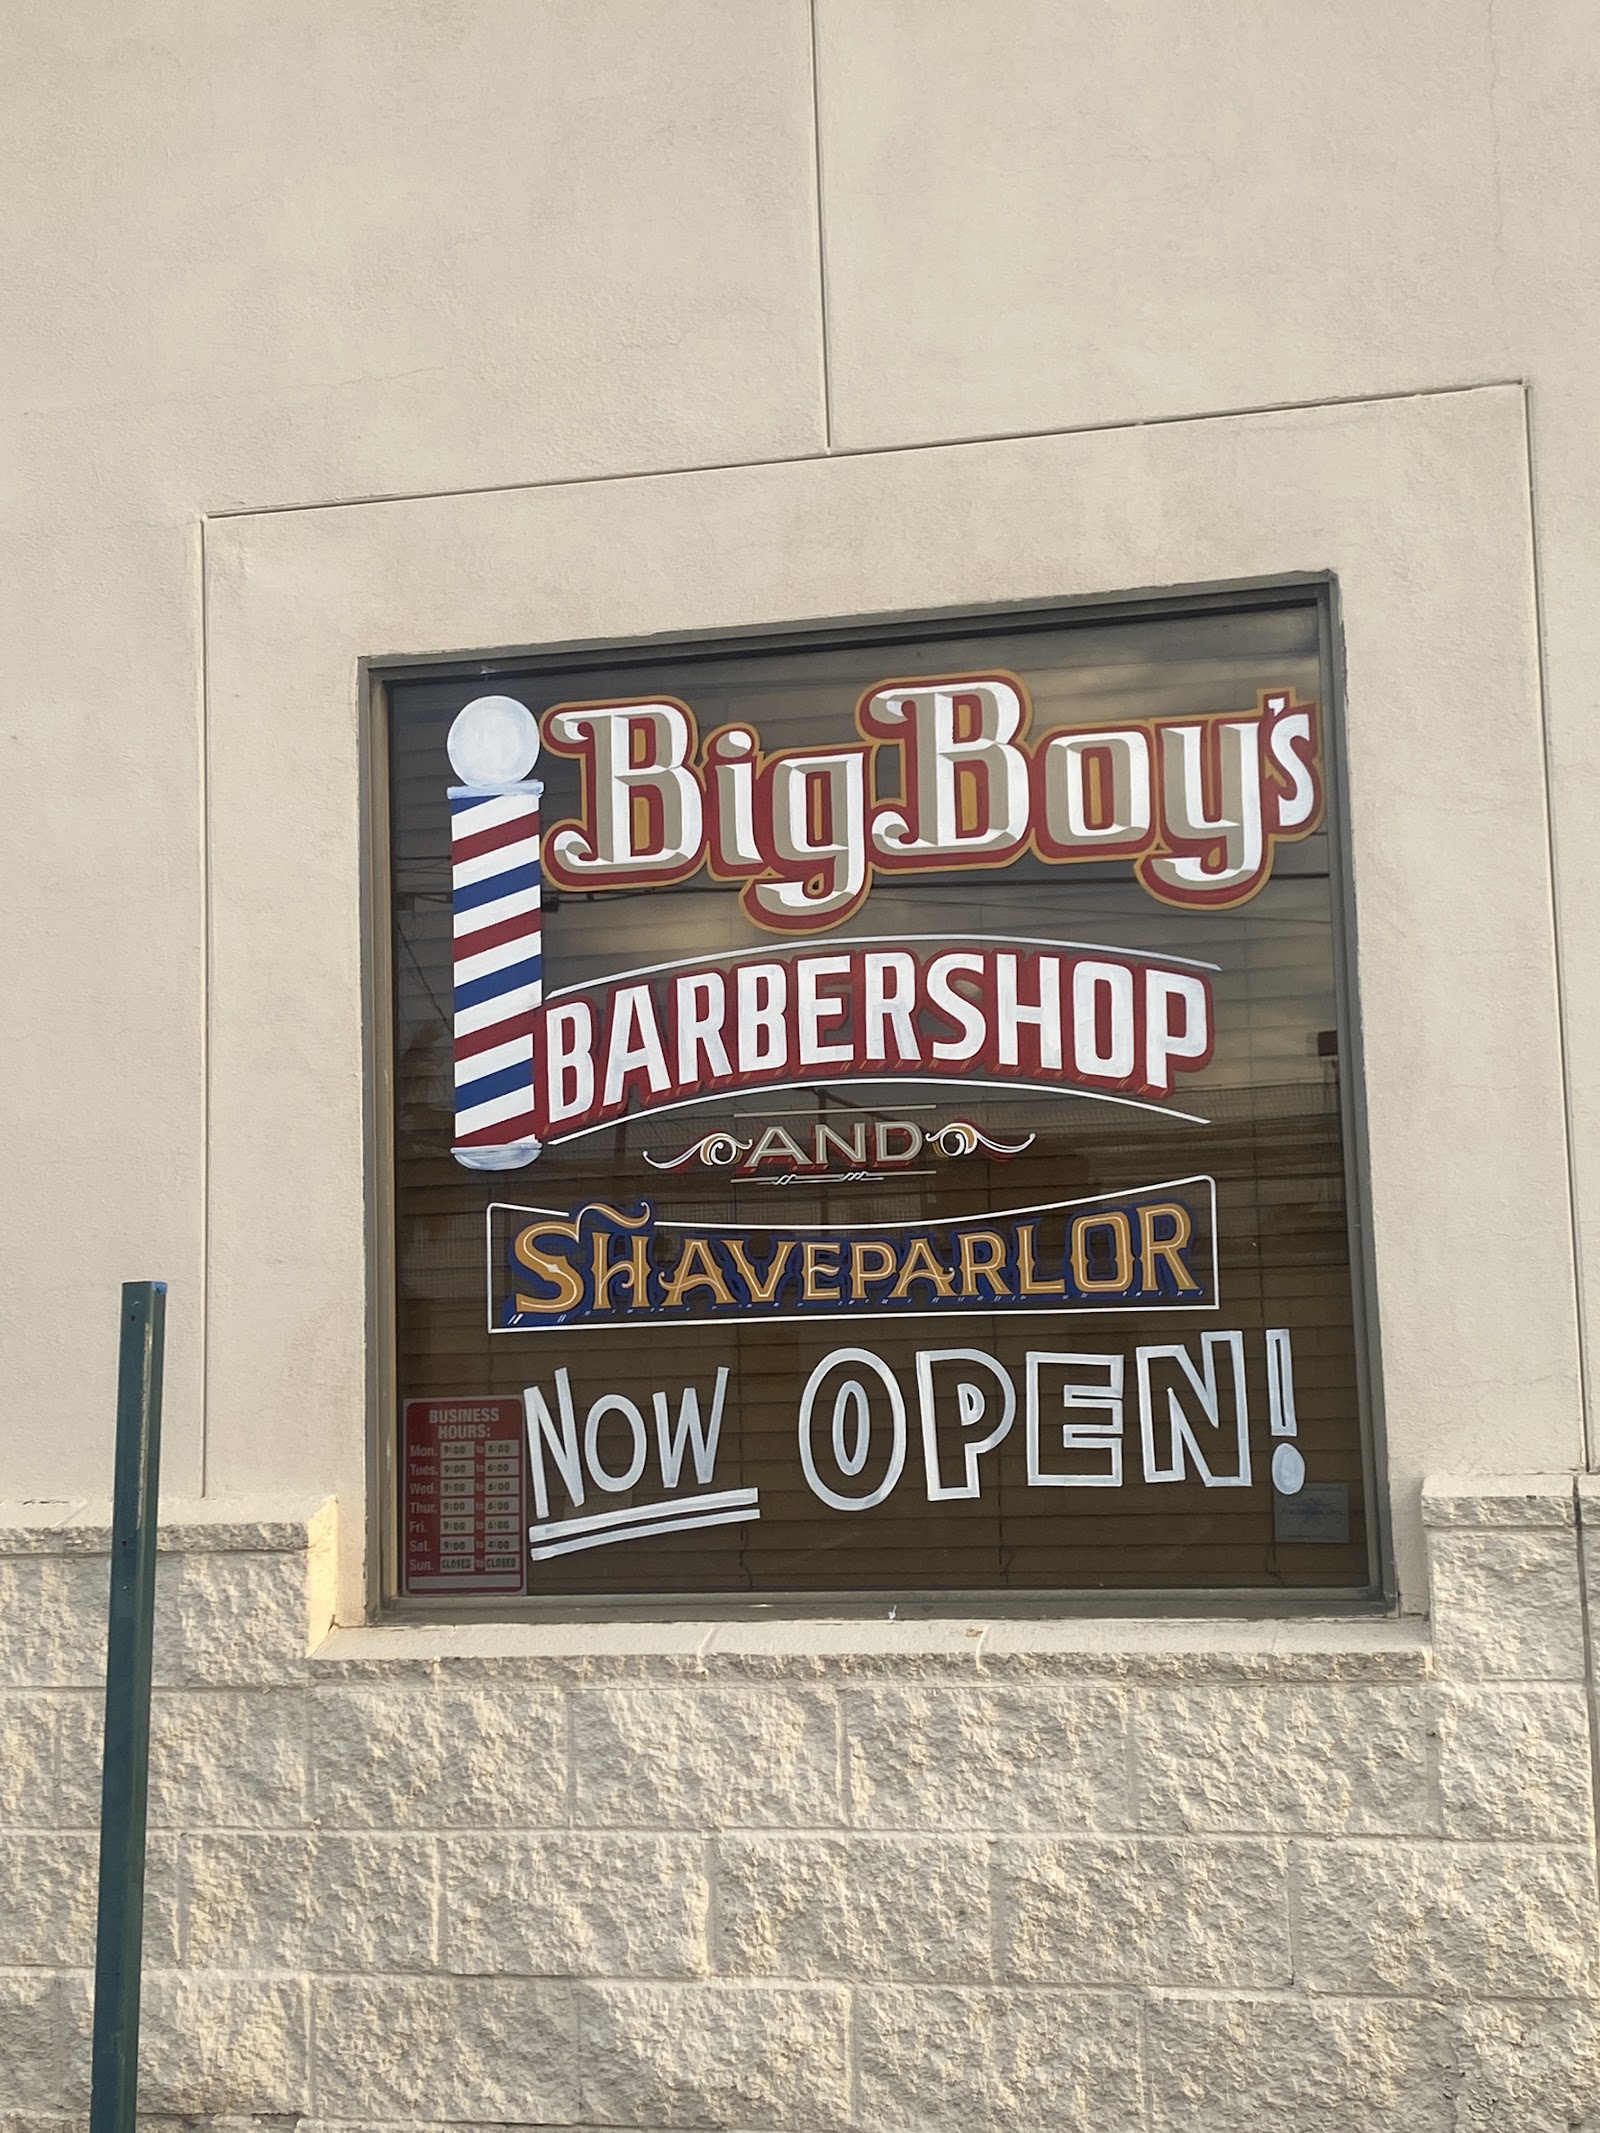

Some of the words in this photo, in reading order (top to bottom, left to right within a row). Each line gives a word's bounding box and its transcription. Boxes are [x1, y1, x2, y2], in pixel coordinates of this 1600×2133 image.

[542, 696, 868, 933] Big
[861, 671, 1320, 909] Boy's
[541, 949, 1213, 1125] BARBERSHOP
[745, 1121, 923, 1170] AND
[429, 1408, 500, 1423] BUSINESS
[799, 1329, 1306, 1511] OPEN!
[438, 1424, 491, 1439] HOURS:
[476, 1445, 484, 1454] to
[476, 1464, 484, 1473] to
[476, 1483, 484, 1492] to
[476, 1501, 484, 1511] to
[476, 1520, 484, 1530] to
[476, 1540, 484, 1549] to
[476, 1559, 484, 1568] to
